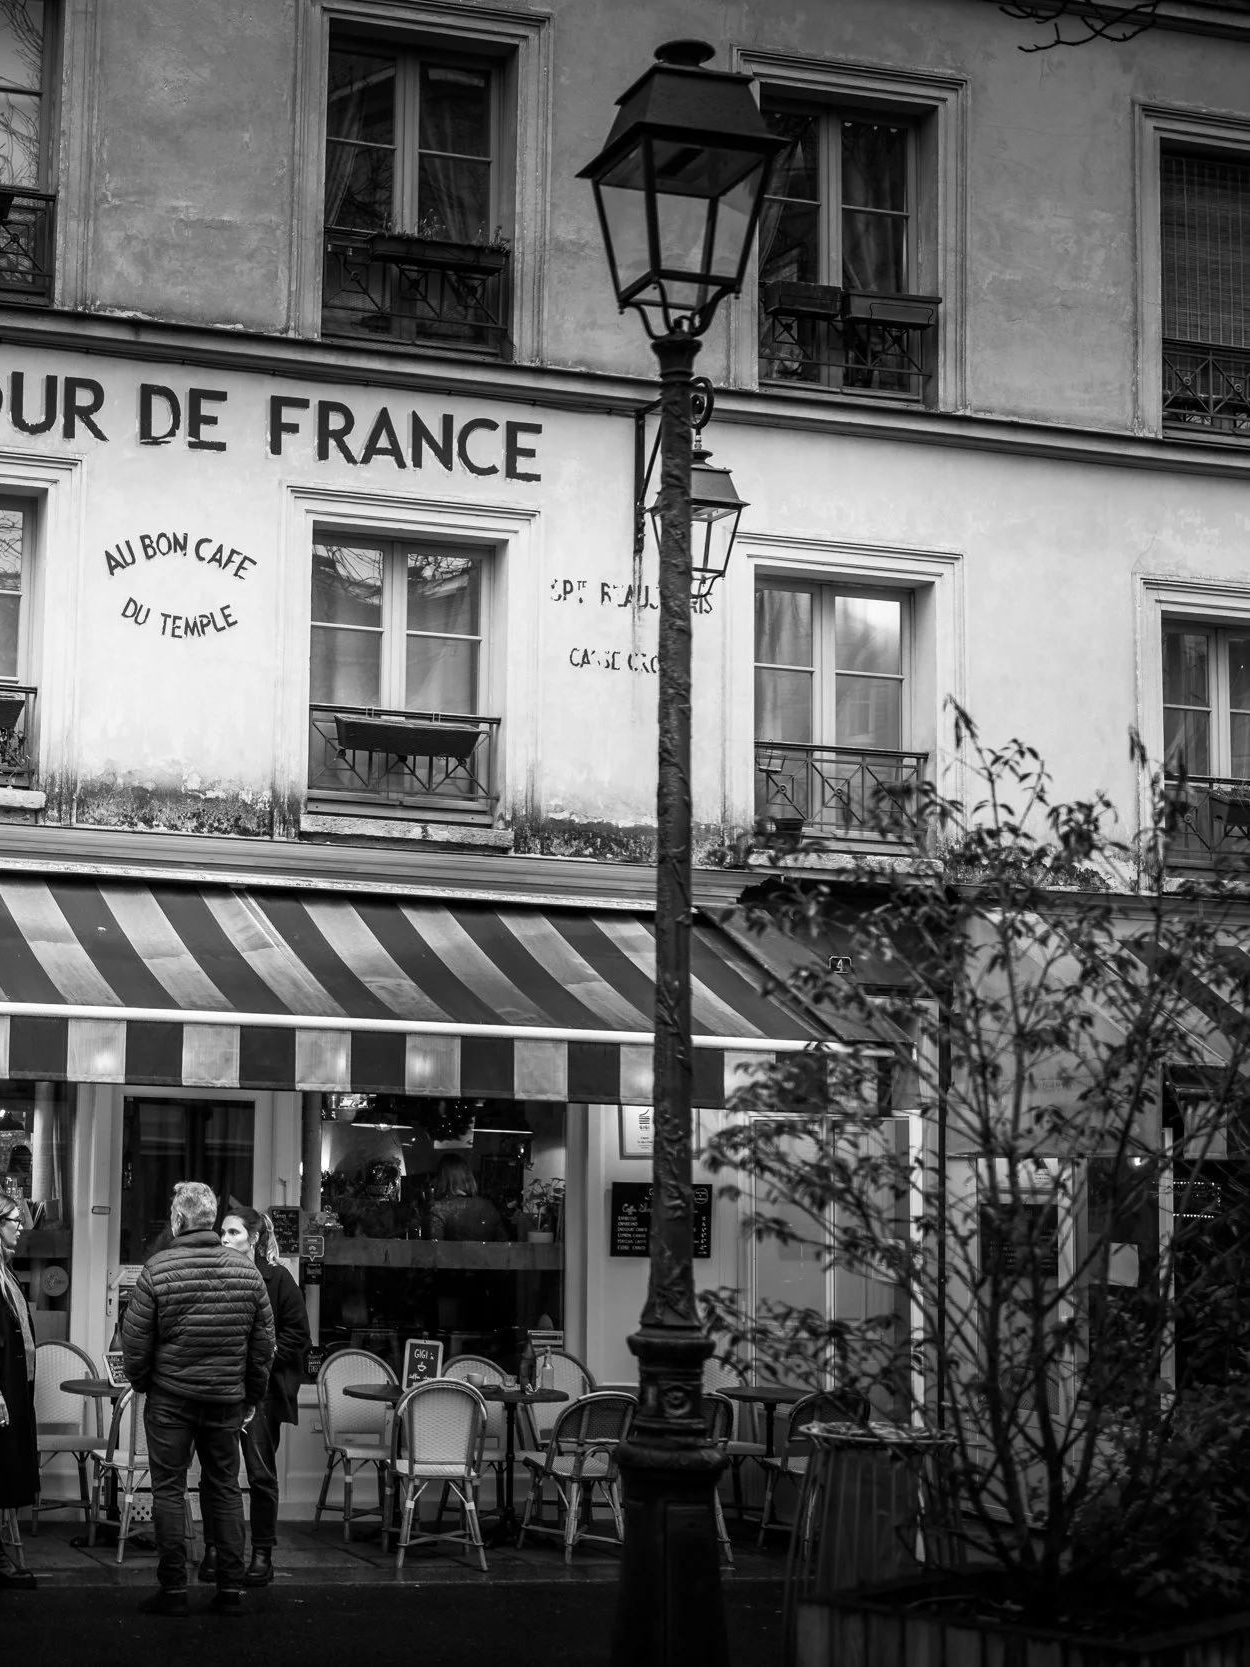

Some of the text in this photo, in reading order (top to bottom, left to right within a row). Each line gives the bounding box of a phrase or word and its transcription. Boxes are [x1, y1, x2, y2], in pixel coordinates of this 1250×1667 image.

[139, 383, 228, 452] DE
[269, 395, 543, 483] FRANCE
[104, 540, 138, 577] AU
[143, 532, 189, 561] BON
[121, 596, 239, 639] DU TEMPLE
